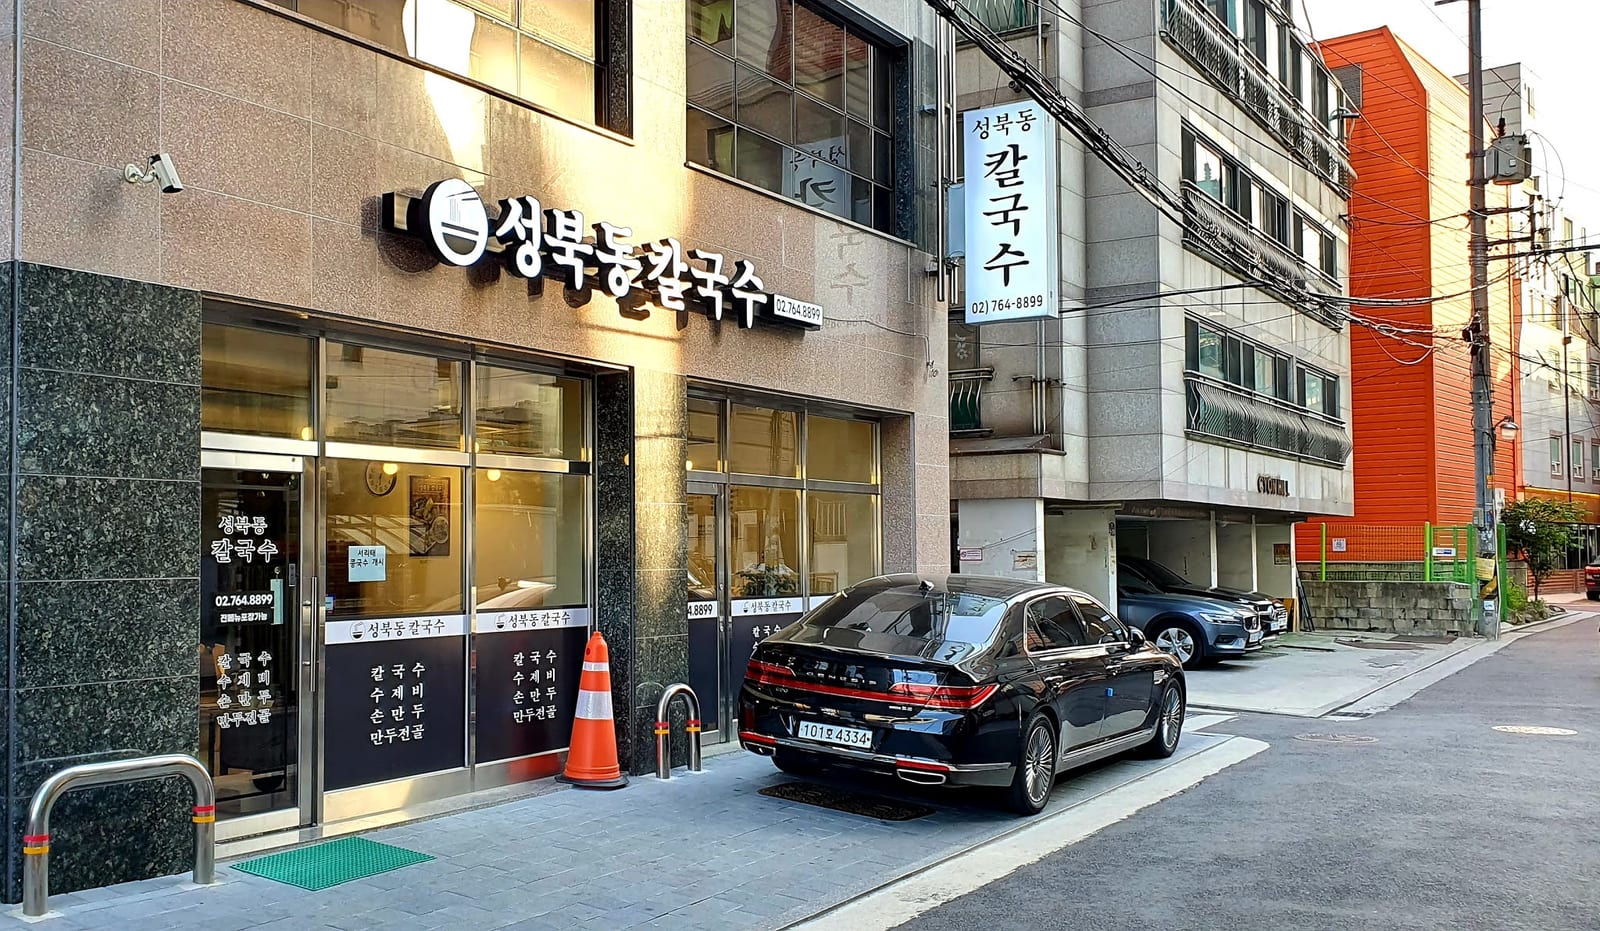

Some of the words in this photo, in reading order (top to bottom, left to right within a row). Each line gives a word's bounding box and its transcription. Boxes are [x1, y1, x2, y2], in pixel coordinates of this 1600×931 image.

[971, 108, 1037, 140] 성북동
[983, 144, 1029, 287] 칼국수
[776, 298, 821, 321] 02.764.8899
[218, 515, 268, 535] 성북동
[211, 538, 279, 563] 칼국수
[371, 558, 384, 566] 개시
[215, 594, 273, 607] 02.764.8899
[806, 671, 877, 685] GENESIS
[216, 708, 272, 729] 만두전골
[512, 705, 557, 724] 만두전골
[370, 724, 425, 746] 만두전골
